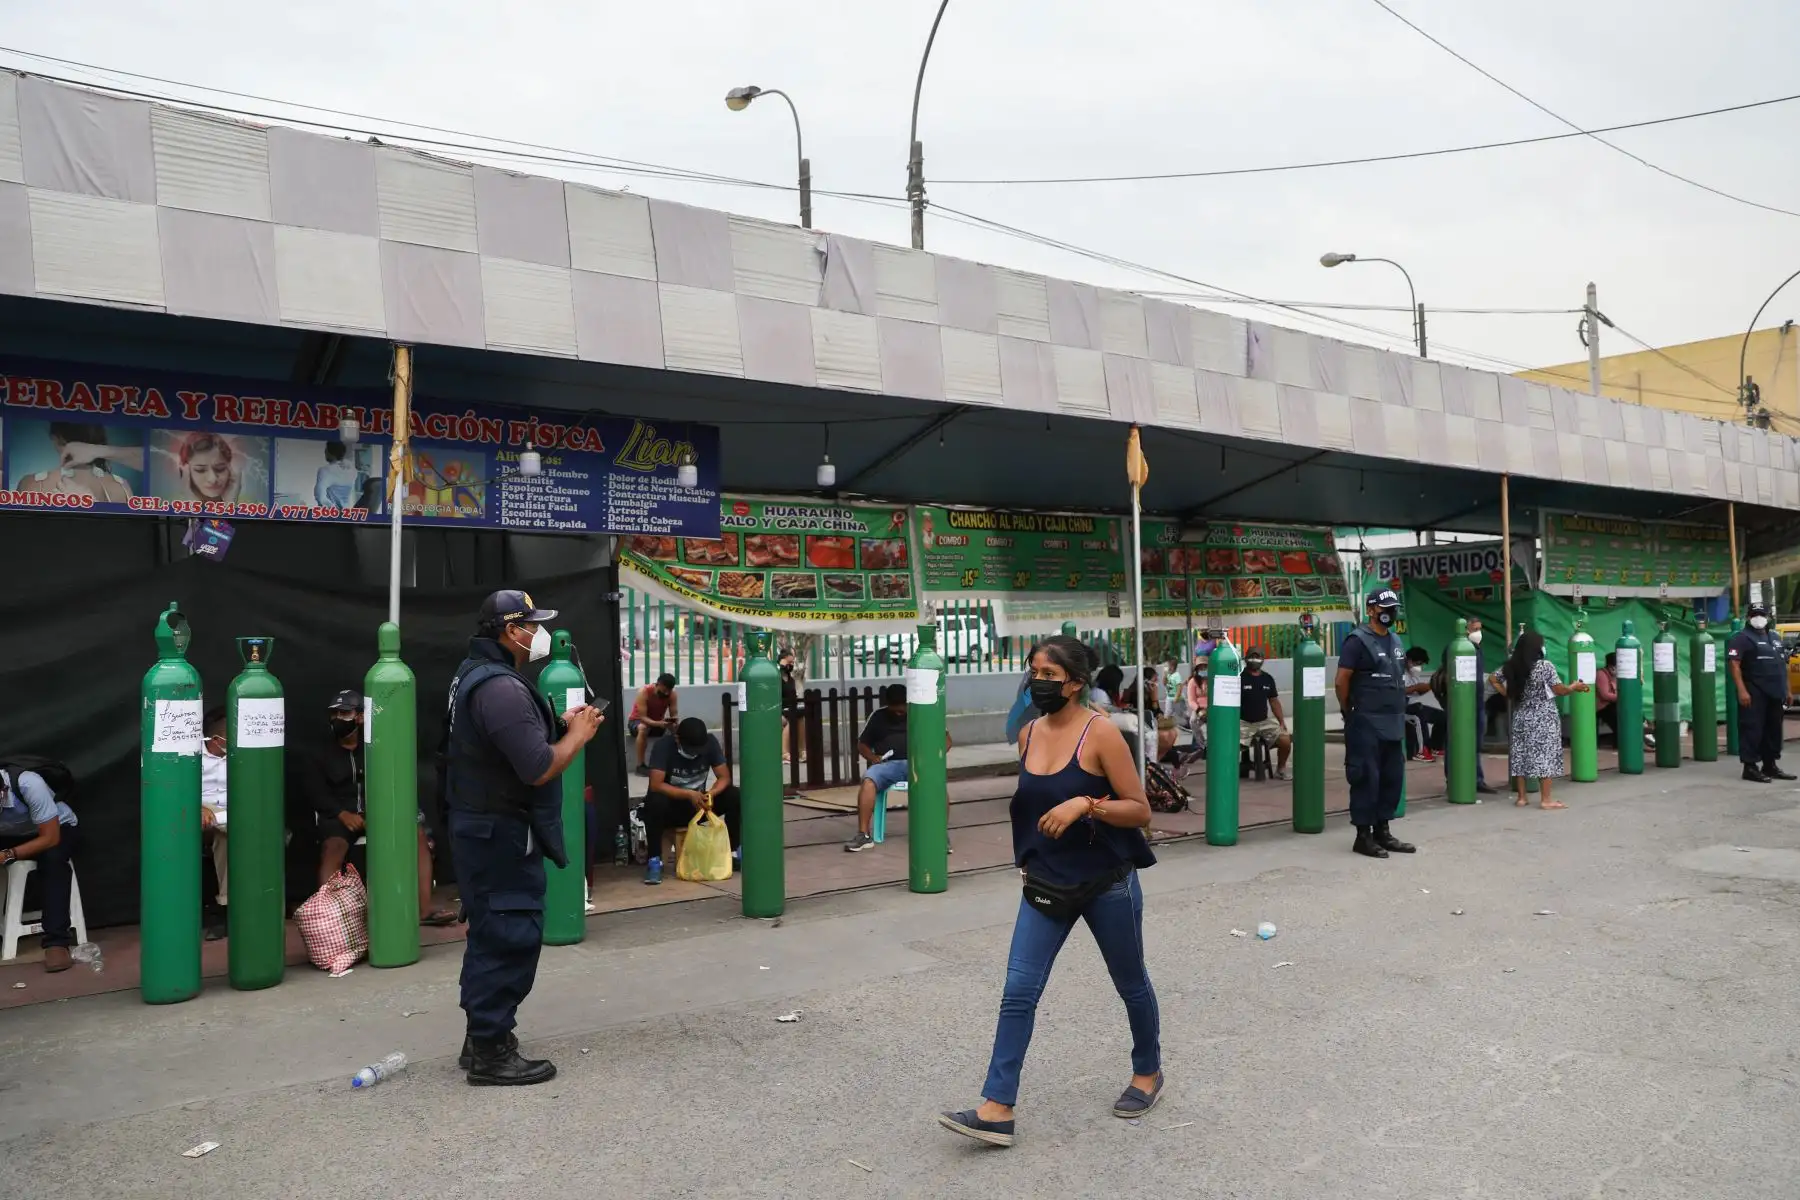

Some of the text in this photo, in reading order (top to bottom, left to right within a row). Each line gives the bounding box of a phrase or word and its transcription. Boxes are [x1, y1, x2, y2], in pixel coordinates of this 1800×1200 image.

[176, 391, 207, 420] Y
[508, 416, 605, 452] FÍSICA
[548, 468, 589, 479] Hombro
[609, 473, 680, 486] Dolor de Rodill
[502, 482, 590, 496] Espolon Calcaneo
[608, 481, 636, 491] Dolor
[637, 482, 649, 492] de
[684, 486, 716, 497] Ciatico
[502, 490, 572, 503] Post Fractura
[607, 497, 658, 509] Lumbalgia
[608, 489, 711, 504] Contractura Muscular
[128, 496, 170, 511] CEL:
[172, 500, 202, 515] 915
[205, 501, 236, 515] 254
[238, 502, 268, 516] 296
[281, 504, 309, 519] 977
[312, 505, 339, 519] 566
[342, 506, 369, 522] 277
[454, 505, 484, 515] PODAL
[502, 499, 578, 513] Paralisis Facial
[607, 505, 649, 516] Artrosis
[763, 505, 854, 521] HUARALINO
[502, 508, 552, 519] Escoliosis
[608, 513, 683, 526] Dolor de Cabeza
[950, 511, 997, 528] CHANCHO
[999, 513, 1011, 529] AL
[502, 516, 587, 530] Dolor de Espalda
[607, 522, 671, 533] Hernia Discal
[762, 515, 771, 529] Y
[776, 517, 820, 530] CAJA
[822, 518, 869, 533] CHINA
[939, 535, 962, 546] COMBO
[719, 605, 773, 617] EVENTOS
[788, 611, 806, 619] 950
[810, 611, 826, 620] 127
[831, 612, 848, 621] 190
[857, 612, 874, 620] 948
[878, 611, 895, 620] 369
